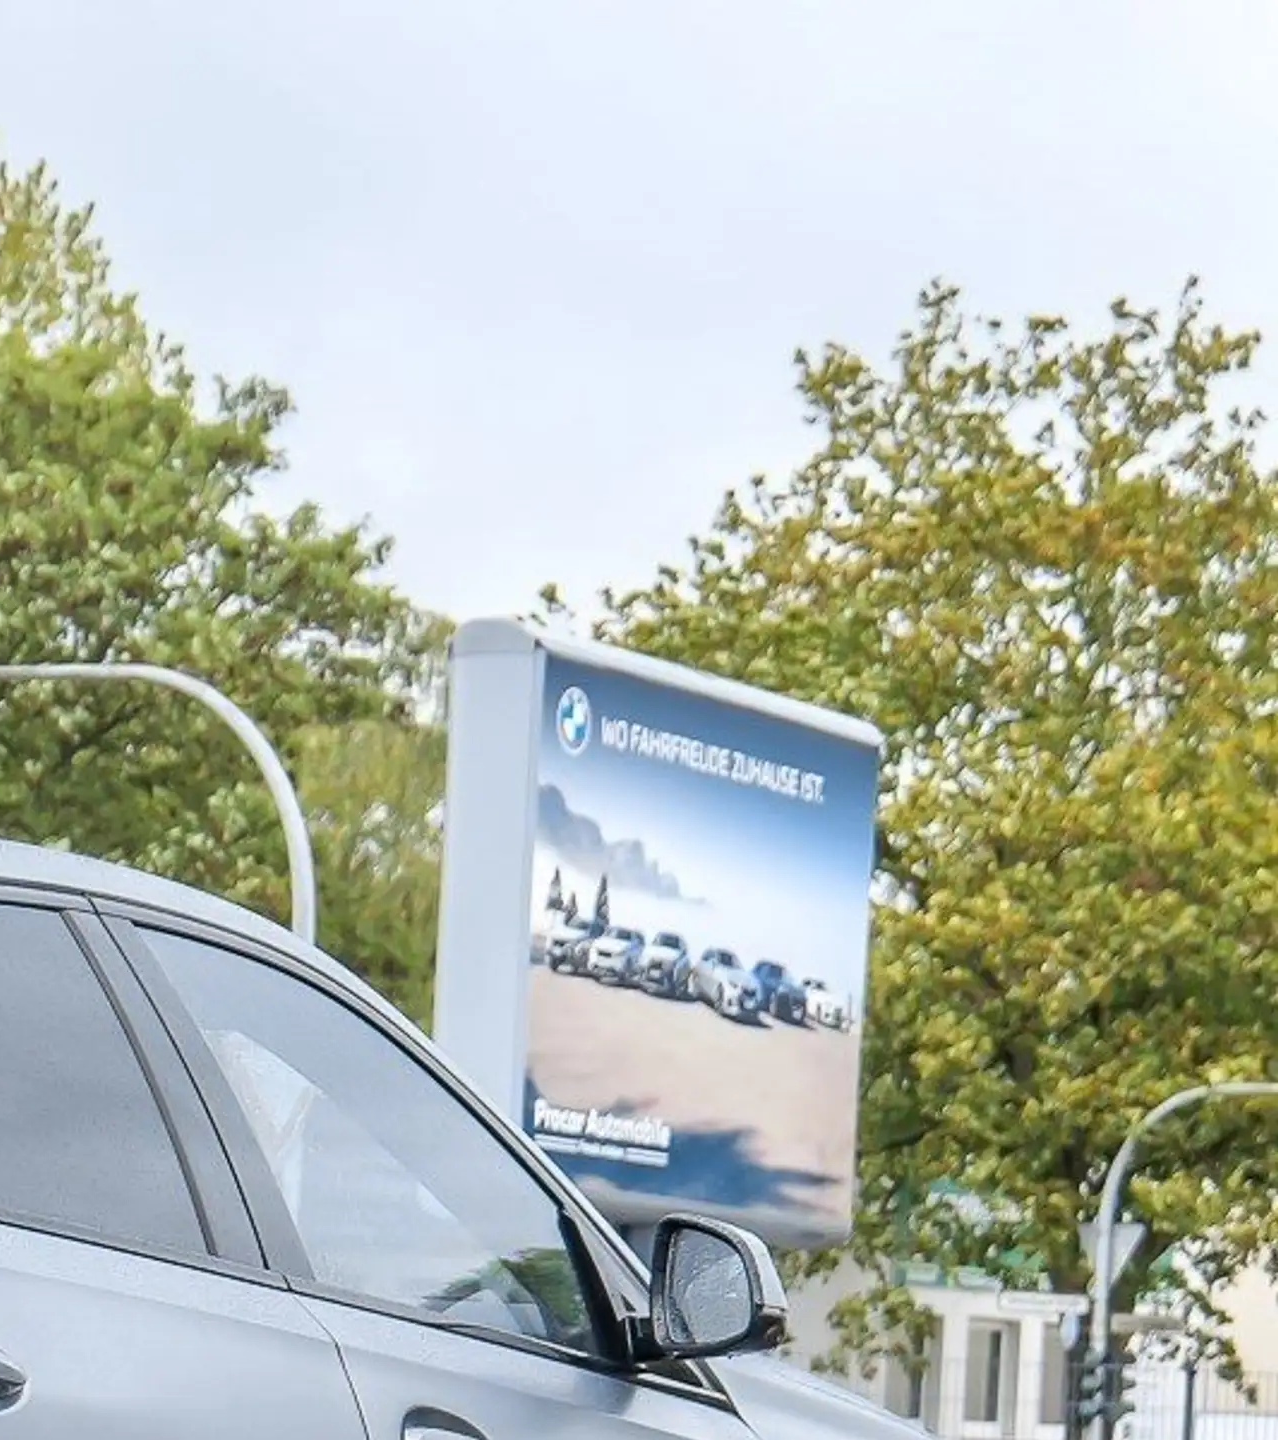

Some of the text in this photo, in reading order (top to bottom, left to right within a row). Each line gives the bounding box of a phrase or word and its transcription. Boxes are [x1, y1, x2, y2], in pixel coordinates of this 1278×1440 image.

[600, 716, 628, 752] WO
[629, 723, 731, 777] FAHRFREUDE
[730, 750, 800, 796] ZUHAUSE
